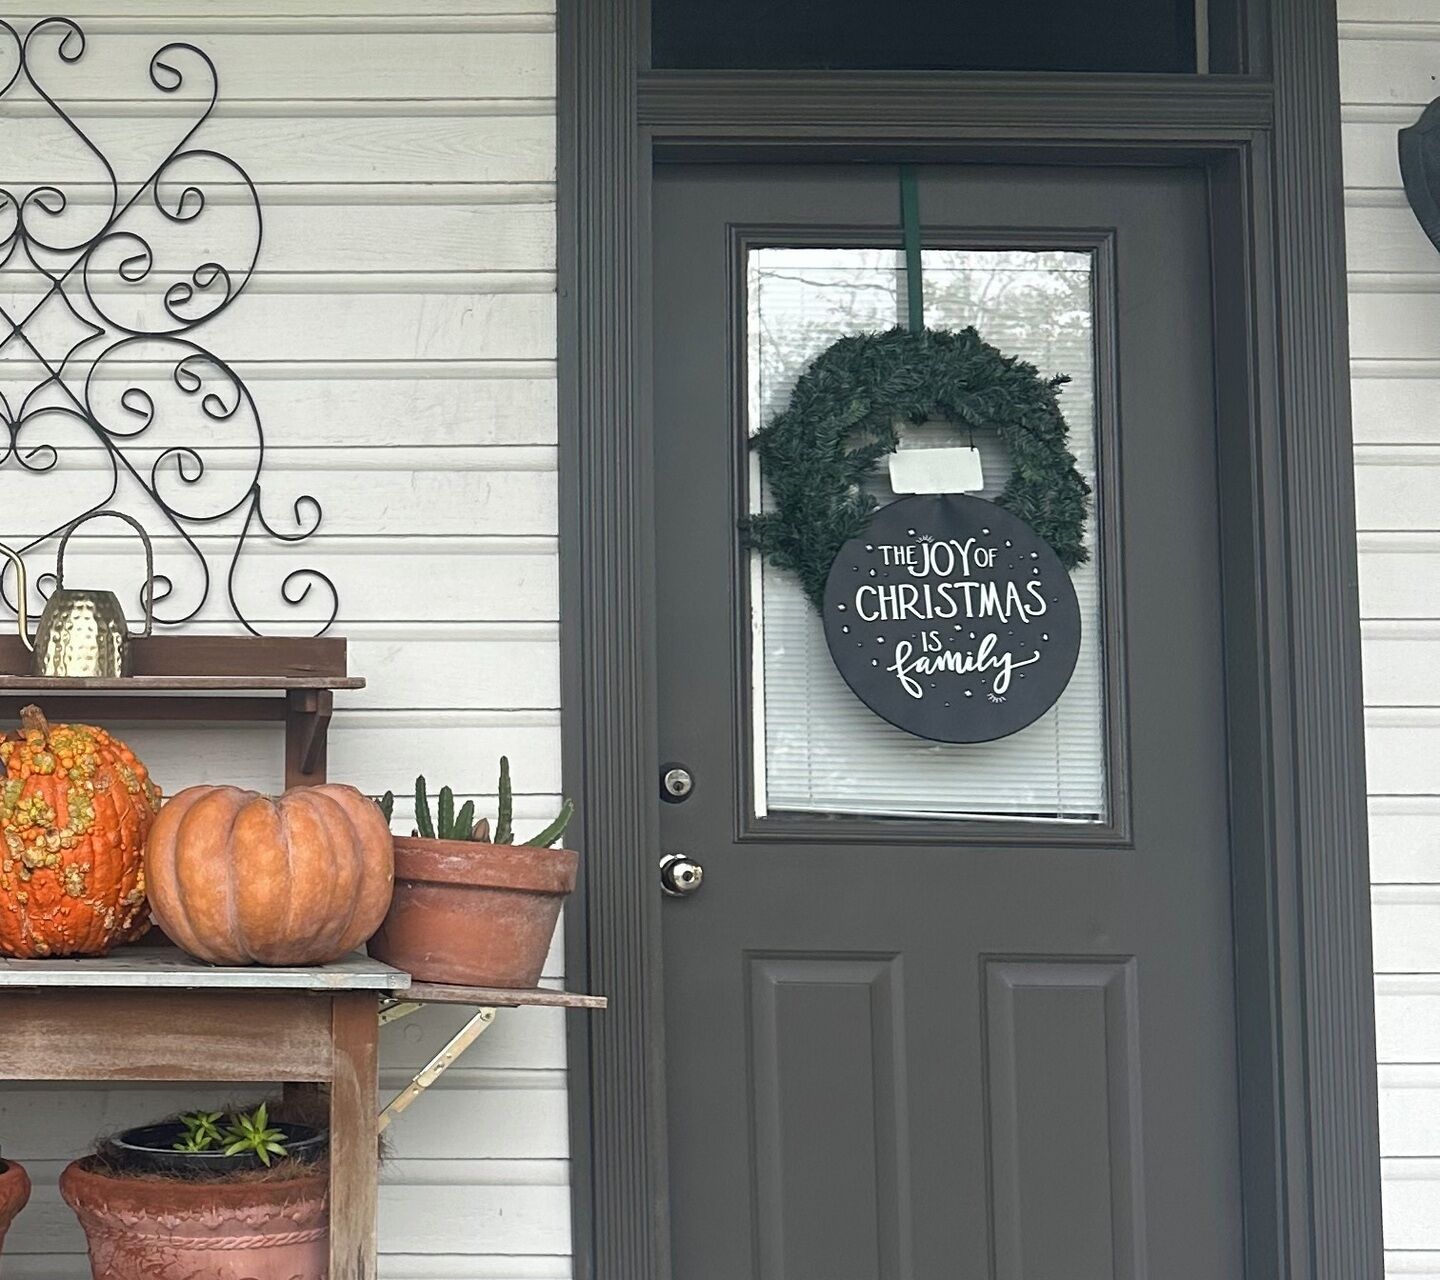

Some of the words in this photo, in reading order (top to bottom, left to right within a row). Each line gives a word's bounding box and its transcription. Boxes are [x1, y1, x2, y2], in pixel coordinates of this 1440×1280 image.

[878, 545, 918, 566] THE
[907, 538, 976, 577] JOY
[974, 547, 999, 568] OF
[855, 580, 1047, 624] CHRISTMAS
[921, 630, 943, 652] IS
[886, 633, 1040, 699] family
